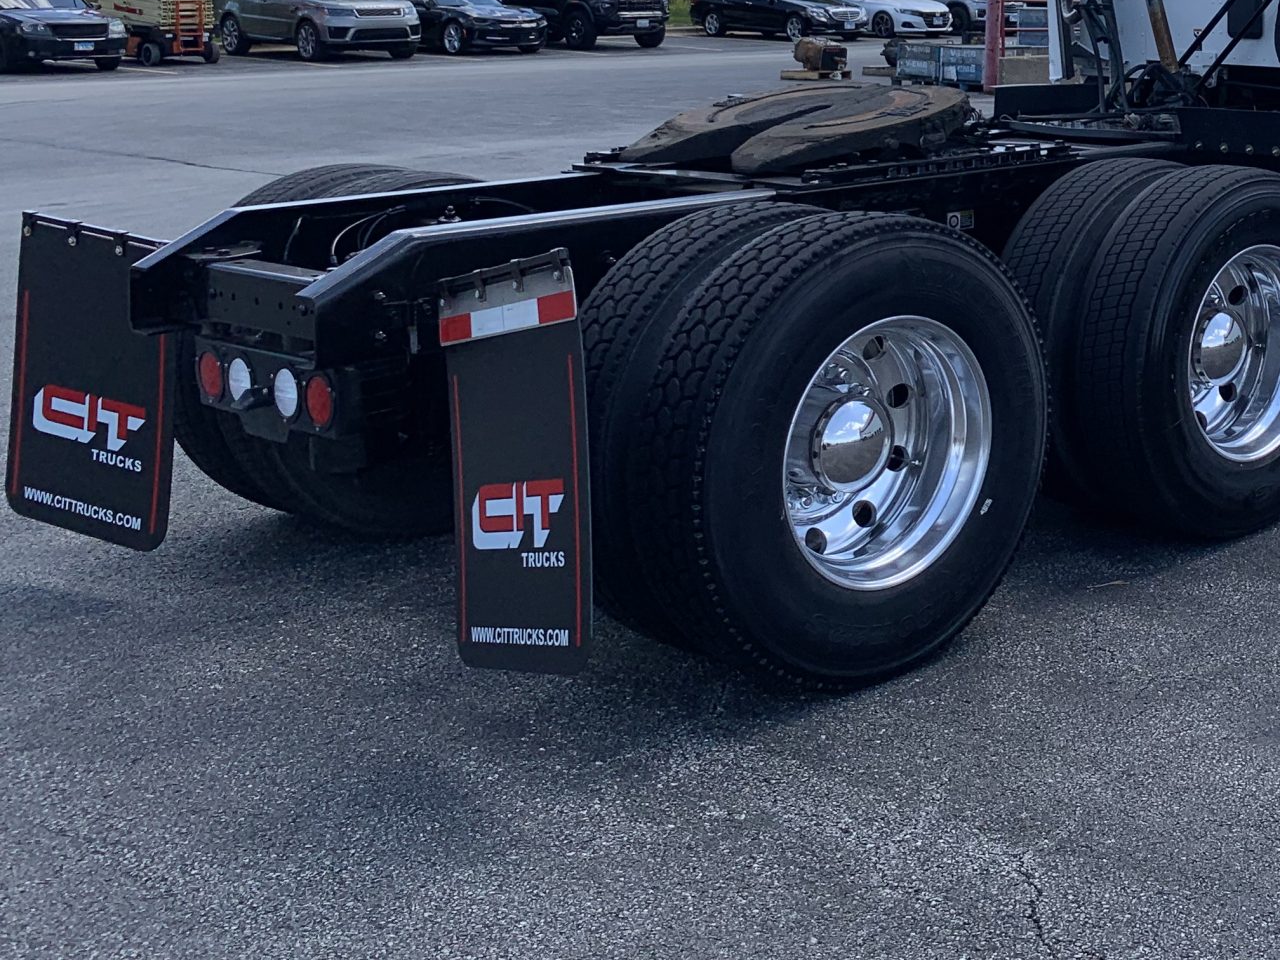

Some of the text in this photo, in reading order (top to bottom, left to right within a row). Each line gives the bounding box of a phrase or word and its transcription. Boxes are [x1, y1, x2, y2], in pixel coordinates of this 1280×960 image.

[33, 384, 146, 452] CIT
[91, 448, 142, 472] TRUCKS
[24, 486, 142, 531] WWW.CITTRUCKS.COM
[472, 478, 565, 550] CIT
[521, 551, 565, 568] TRUCKS
[471, 626, 569, 646] WWW.CITTRUCKS.COM
